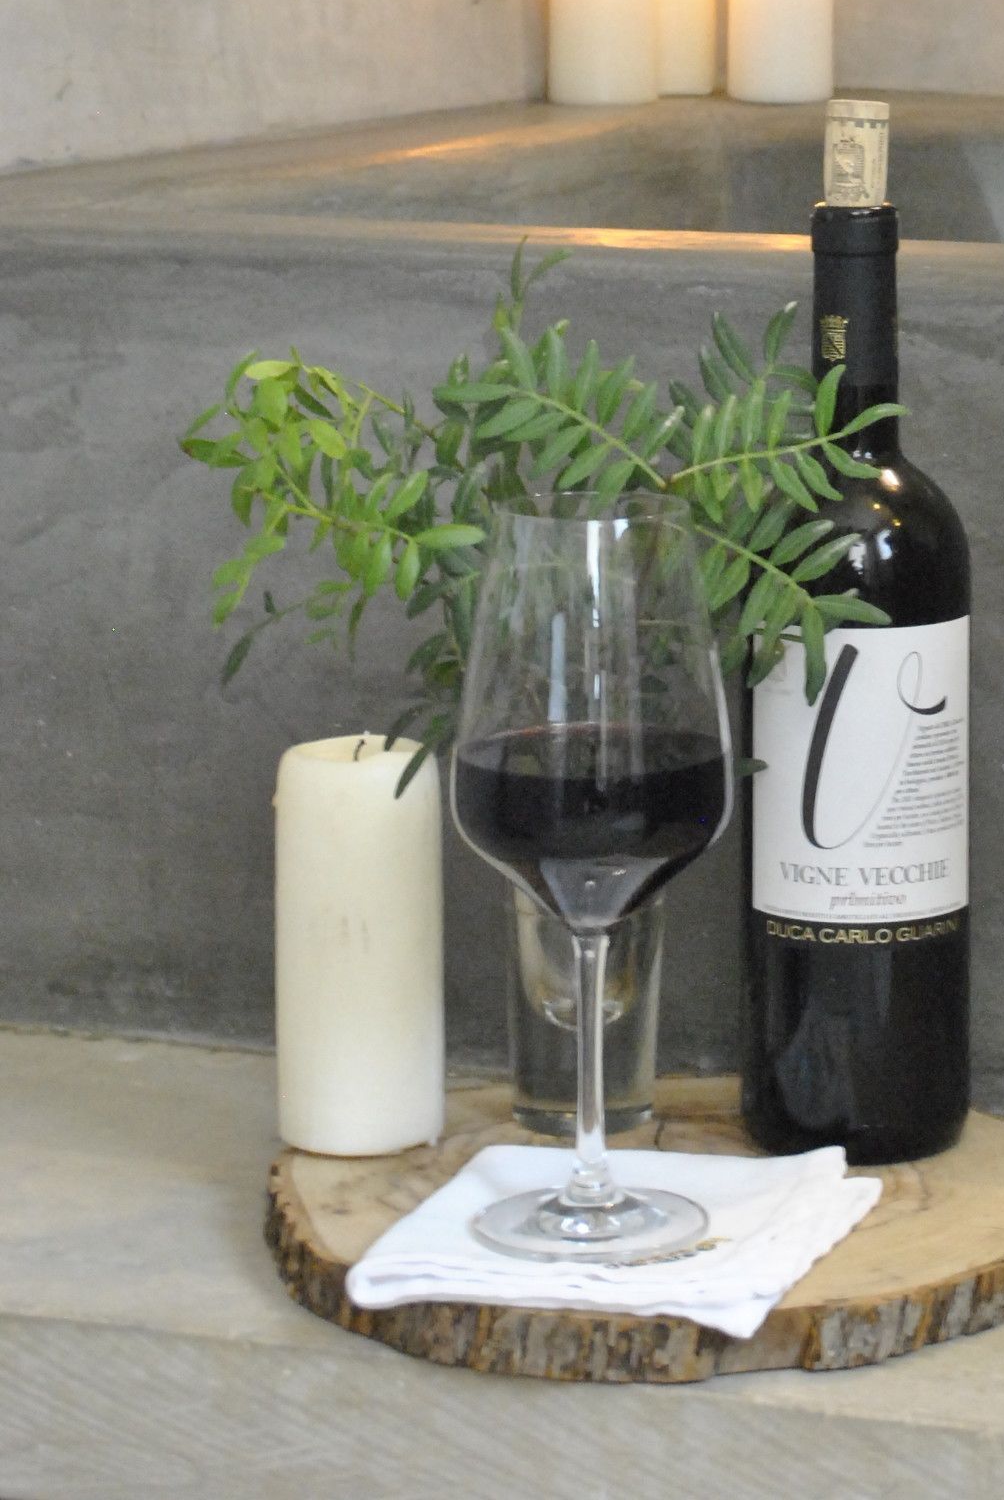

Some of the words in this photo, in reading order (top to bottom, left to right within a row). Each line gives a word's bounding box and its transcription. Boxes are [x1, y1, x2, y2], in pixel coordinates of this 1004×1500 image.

[779, 861, 848, 886] VIGNE
[858, 858, 949, 886] VECCHIE
[766, 920, 817, 942] DUCA
[818, 928, 893, 945] CARLO
